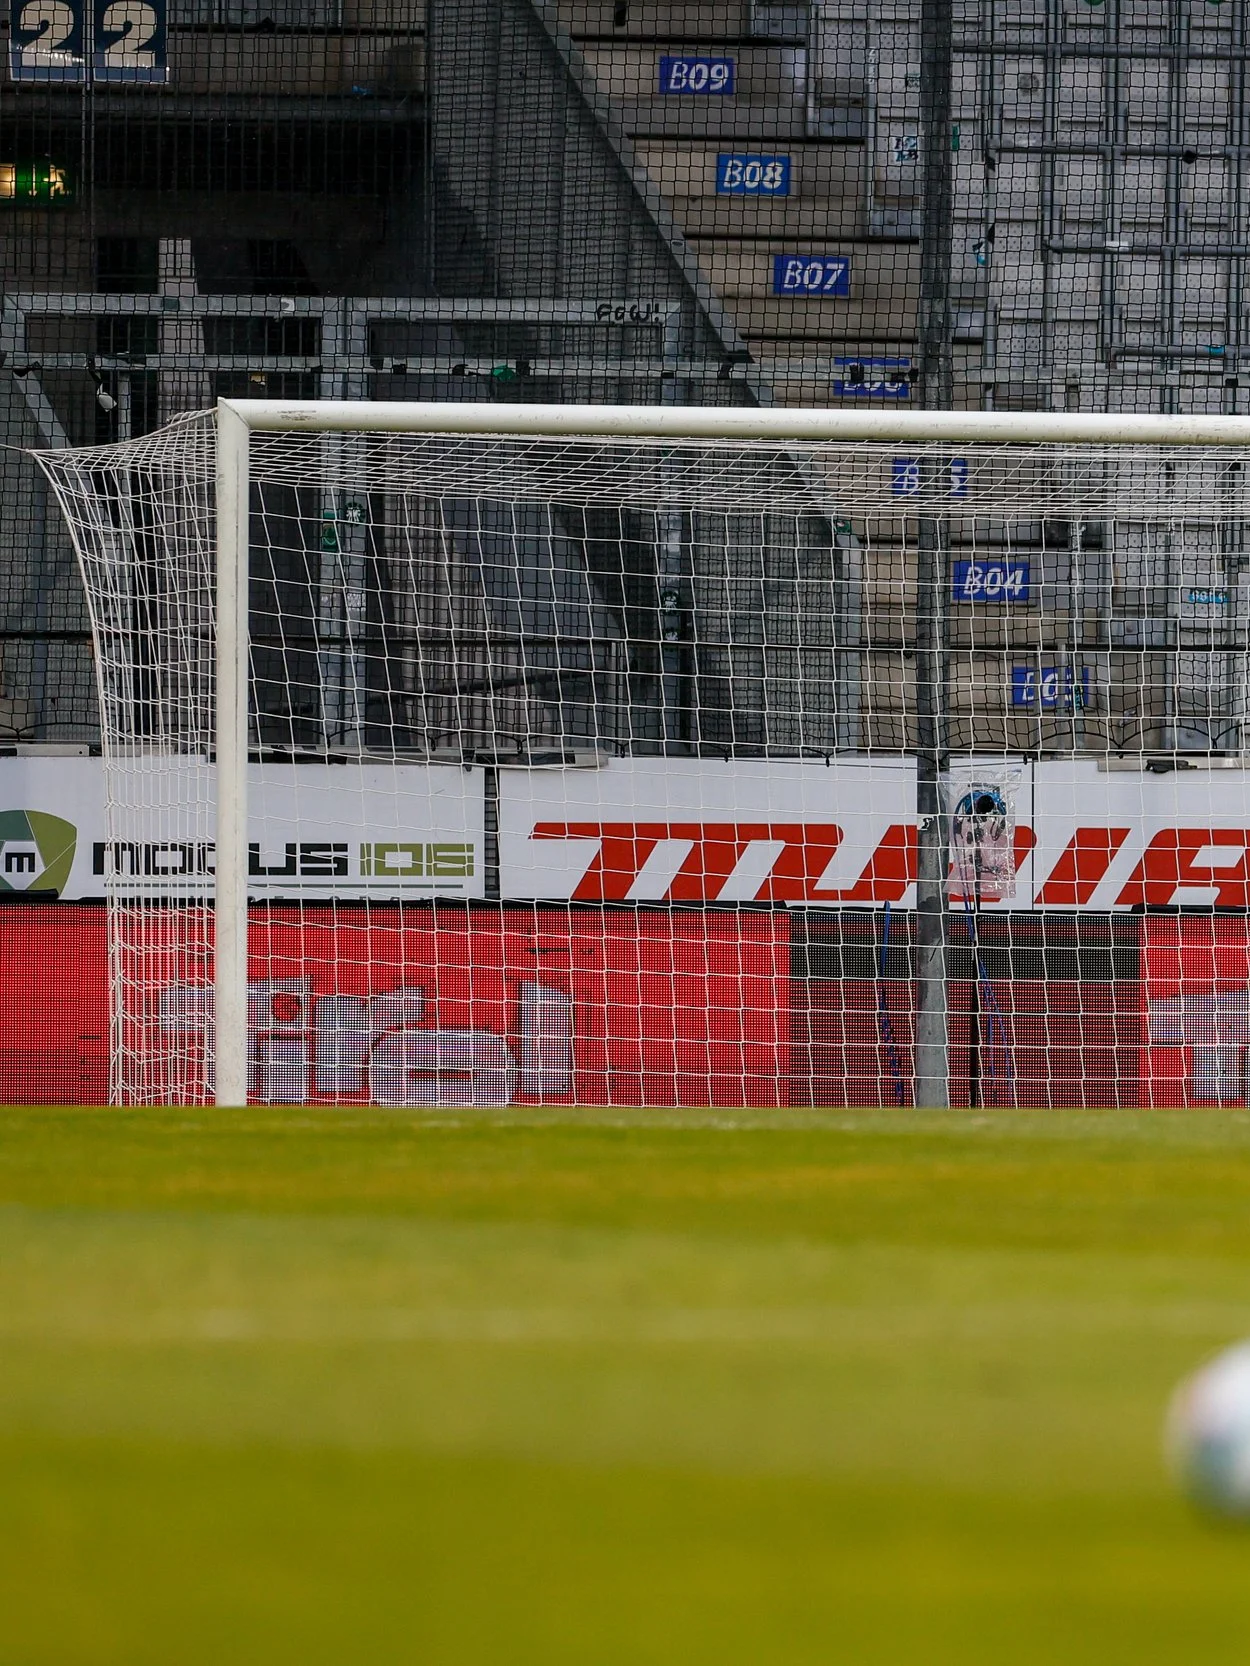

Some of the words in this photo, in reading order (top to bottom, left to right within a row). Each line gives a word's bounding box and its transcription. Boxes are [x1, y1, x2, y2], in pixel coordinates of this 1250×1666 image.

[669, 61, 729, 91] B09
[723, 159, 784, 189] B08
[783, 260, 844, 290] B07
[902, 464, 964, 491] B5
[963, 566, 1024, 596] B04
